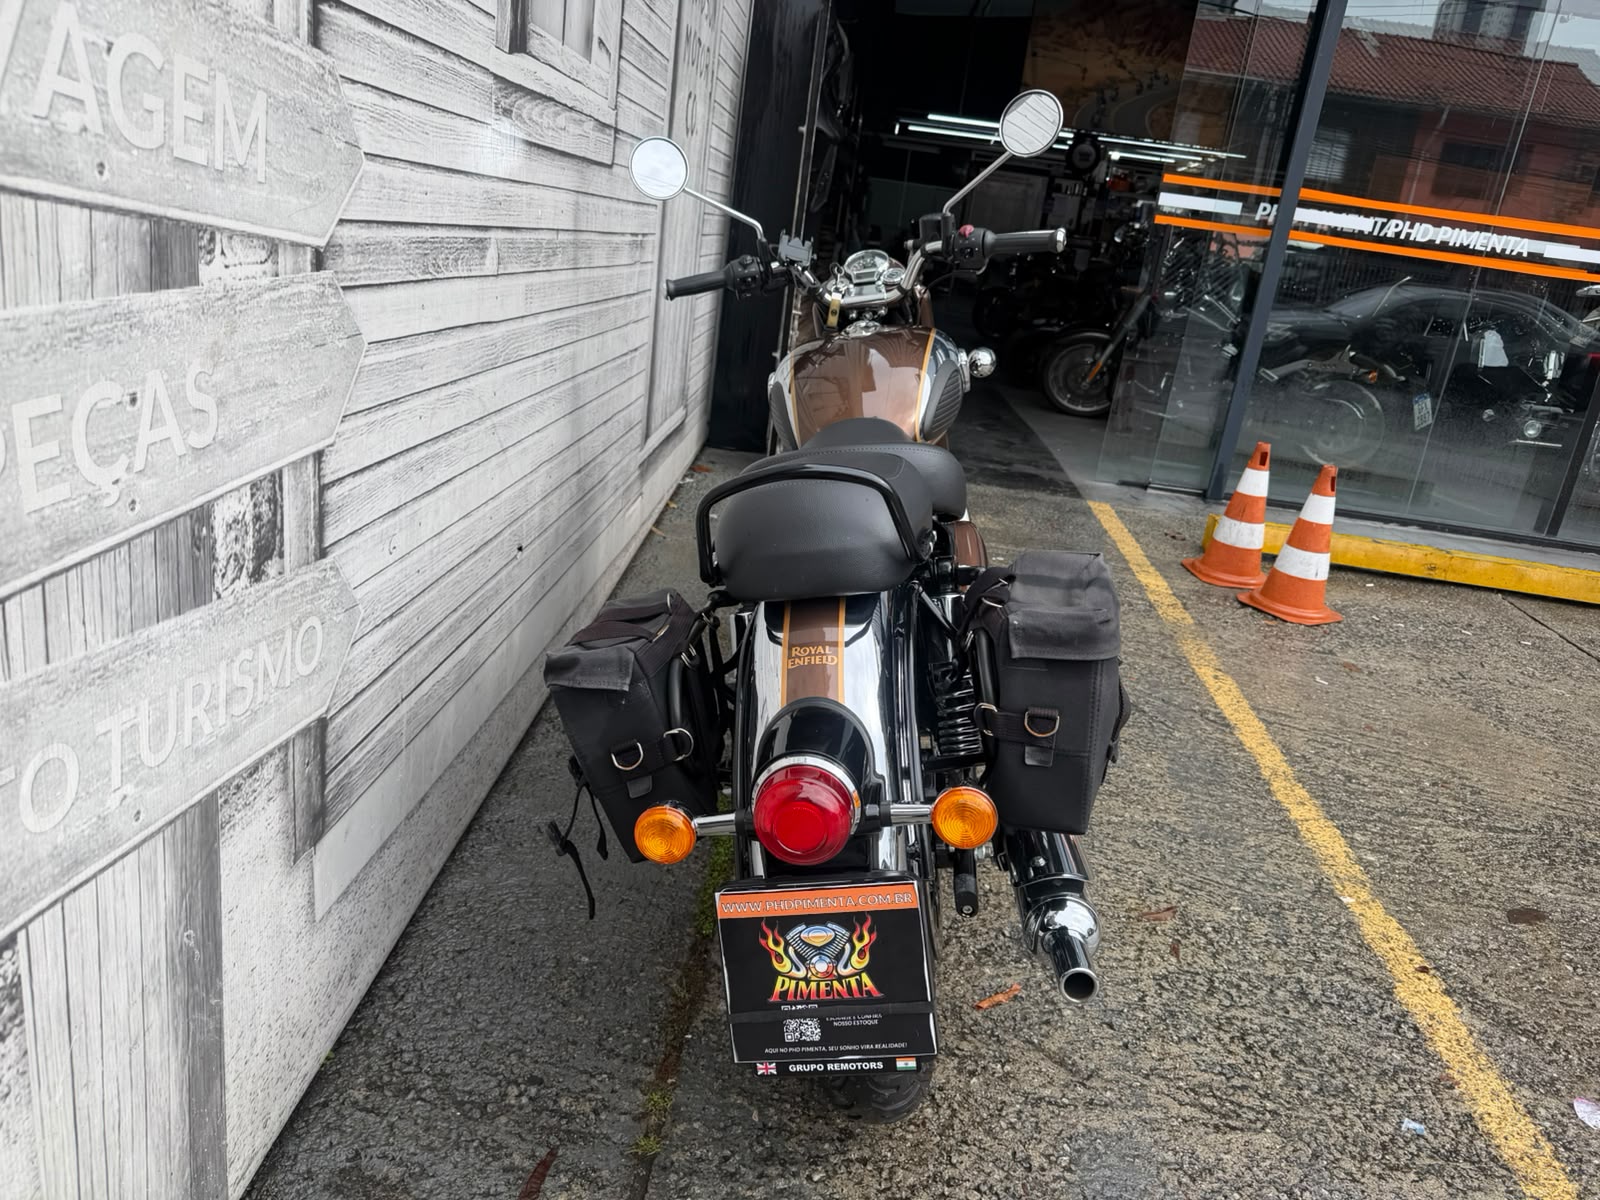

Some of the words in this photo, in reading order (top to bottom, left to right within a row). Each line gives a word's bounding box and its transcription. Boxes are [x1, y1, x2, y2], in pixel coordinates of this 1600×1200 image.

[0, 0, 267, 184] AGEM
[1387, 217, 1434, 242] PHD
[1435, 225, 1529, 257] PIMENTA
[0, 358, 218, 514] EÇAS
[787, 655, 838, 669] ENFIELD
[791, 645, 832, 657] ROYAL
[96, 615, 323, 792] TURISMO
[721, 893, 913, 913] WWW.PHDPIMENTA.COM.BR
[767, 972, 885, 1002] PIMENTA
[788, 1063, 824, 1072] GRUPO
[827, 1061, 884, 1071] REMOTORS
